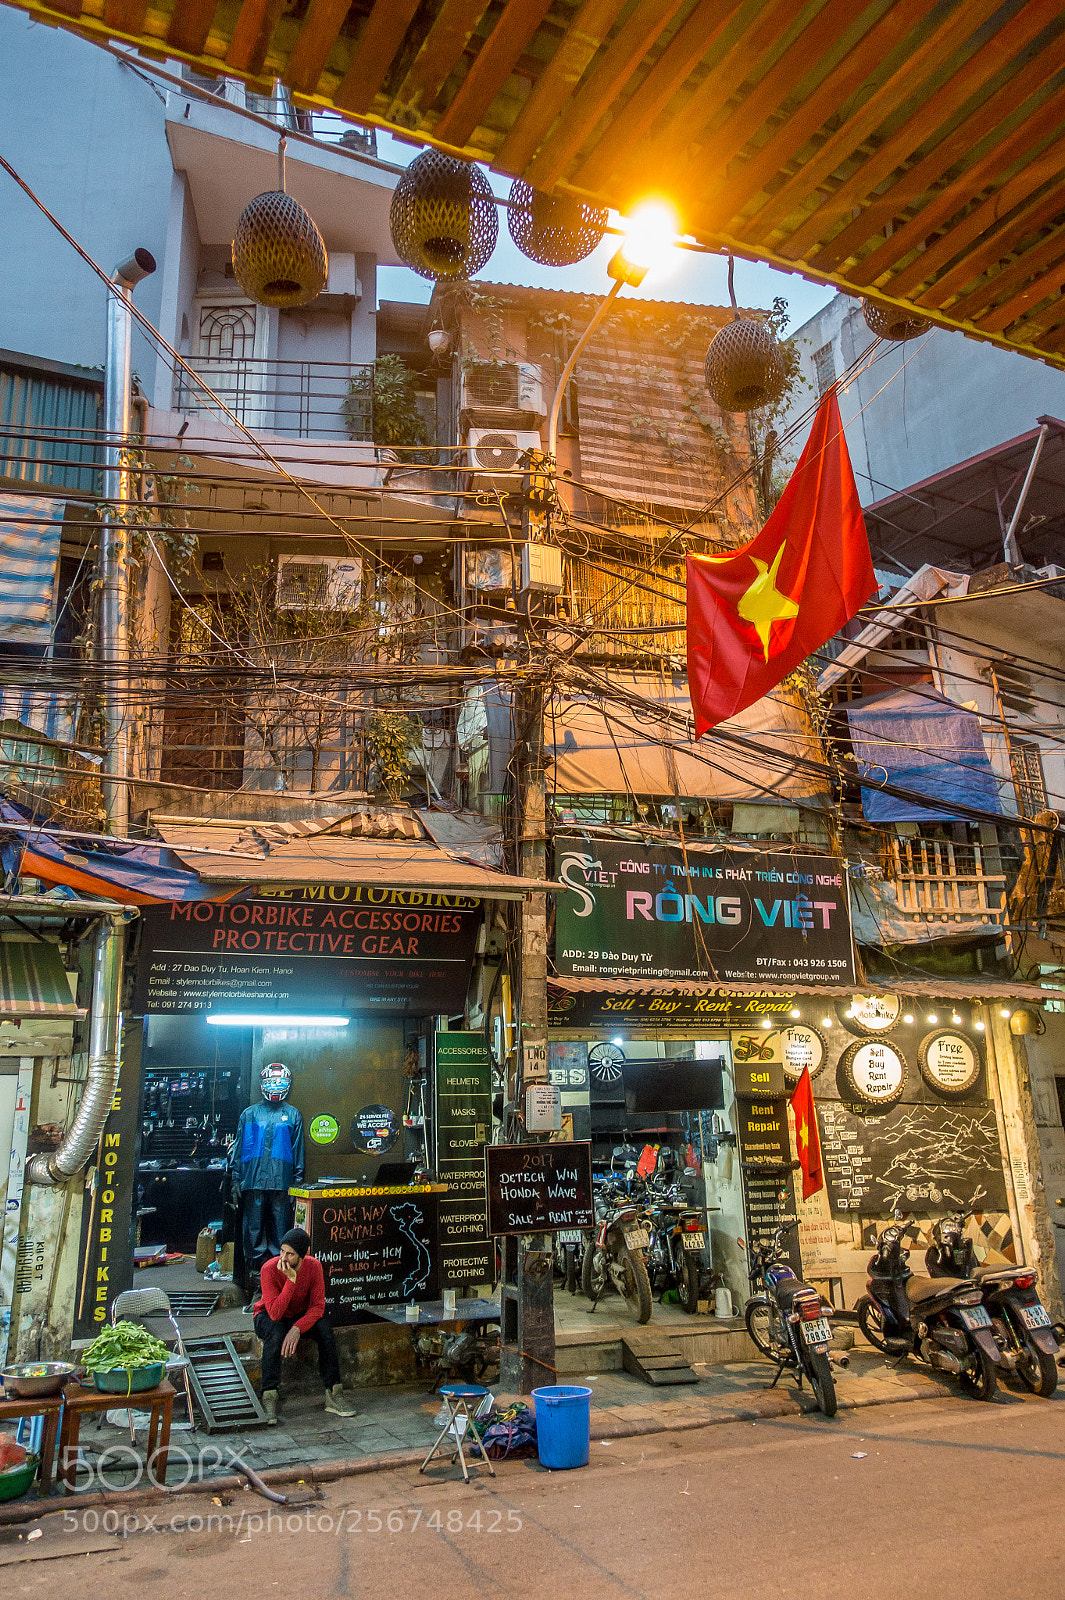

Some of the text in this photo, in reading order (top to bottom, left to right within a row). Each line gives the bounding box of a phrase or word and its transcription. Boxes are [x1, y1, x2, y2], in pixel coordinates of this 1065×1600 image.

[620, 859, 650, 874] CÔNG
[653, 864, 667, 875] TY
[702, 868, 712, 878] IN
[715, 869, 723, 879] &
[583, 870, 618, 883] VIET
[626, 879, 837, 935] RỒNG VIỆT
[170, 902, 462, 933] MOTORBIKE ACCESSORIES
[212, 929, 419, 955] PROTECTIVE GEAR
[562, 950, 585, 958] ADD:
[588, 951, 599, 959] 29
[602, 952, 619, 960] Đào
[622, 953, 638, 963] Duy
[756, 958, 786, 966] ĐT/Fax
[202, 965, 216, 974] Duy
[572, 964, 597, 973] Email:
[725, 970, 757, 978] Website:
[150, 977, 170, 985] Email
[601, 998, 636, 1010] Sell
[648, 998, 682, 1013] Buy
[694, 999, 732, 1012] Rent
[866, 1001, 884, 1010] Style
[787, 1030, 811, 1043] Free
[938, 1040, 963, 1054] Free
[528, 1050, 545, 1060] LNQ
[870, 1048, 884, 1057] Sell
[530, 1062, 539, 1070] 14
[869, 1060, 885, 1069] Buy
[750, 1072, 770, 1082] Sell
[869, 1072, 886, 1080] Rent
[866, 1083, 892, 1092] Repair
[752, 1105, 774, 1115] Rent
[748, 1121, 780, 1132] Repair
[450, 1140, 478, 1148] GLOVES
[523, 1154, 553, 1169] 2017
[499, 1168, 578, 1183] DETECH WIN
[501, 1183, 577, 1201] HONDA WAVE
[323, 1204, 387, 1223] ONE WAY
[508, 1213, 533, 1226] SALE
[549, 1210, 573, 1223] RENT
[330, 1224, 384, 1242] RENTALS
[447, 1225, 483, 1234] CLOTHING
[315, 1250, 342, 1262] HANOI
[382, 1246, 402, 1258] HCM
[443, 1257, 488, 1267] PROTECTIVE
[448, 1268, 485, 1278] CLOTHING
